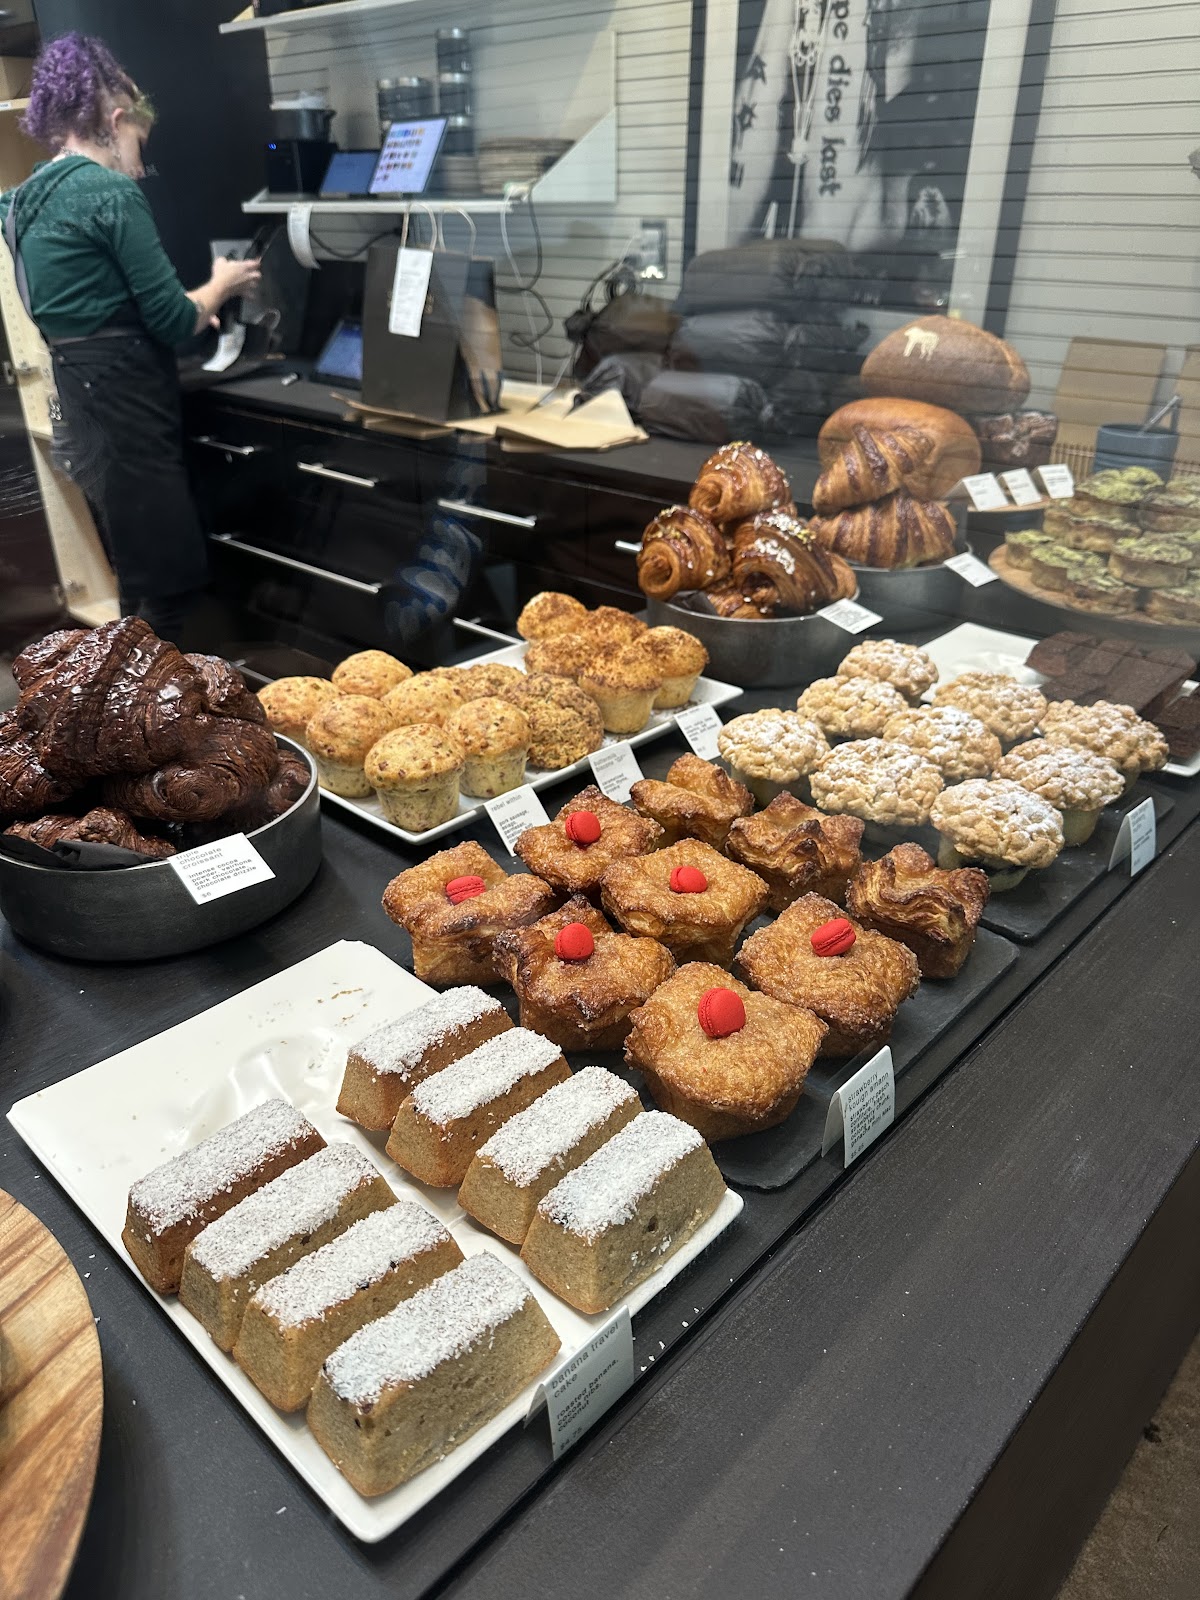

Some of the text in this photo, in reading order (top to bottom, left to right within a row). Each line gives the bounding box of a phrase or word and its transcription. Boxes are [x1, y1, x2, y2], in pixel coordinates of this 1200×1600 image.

[825, 55, 851, 123] dies
[819, 136, 845, 196] last
[492, 794, 522, 812] rebel within
[499, 810, 530, 826] pork sausage,
[176, 850, 199, 860] triple
[180, 848, 222, 864] chocolate
[182, 852, 223, 870] croissant
[188, 859, 238, 878] intense cocoa
[197, 866, 256, 890] chocolate drizzle
[194, 878, 210, 886] dark
[848, 1072, 878, 1103] strawberry
[848, 1072, 889, 1112] kouign amann
[850, 1110, 875, 1134] strawberry
[552, 1322, 619, 1390] banana travel
[554, 1373, 578, 1398] cake
[556, 1358, 619, 1420] roasted banana,
[558, 1383, 602, 1426] cocoa nibs,
[558, 1400, 590, 1432] coconut
